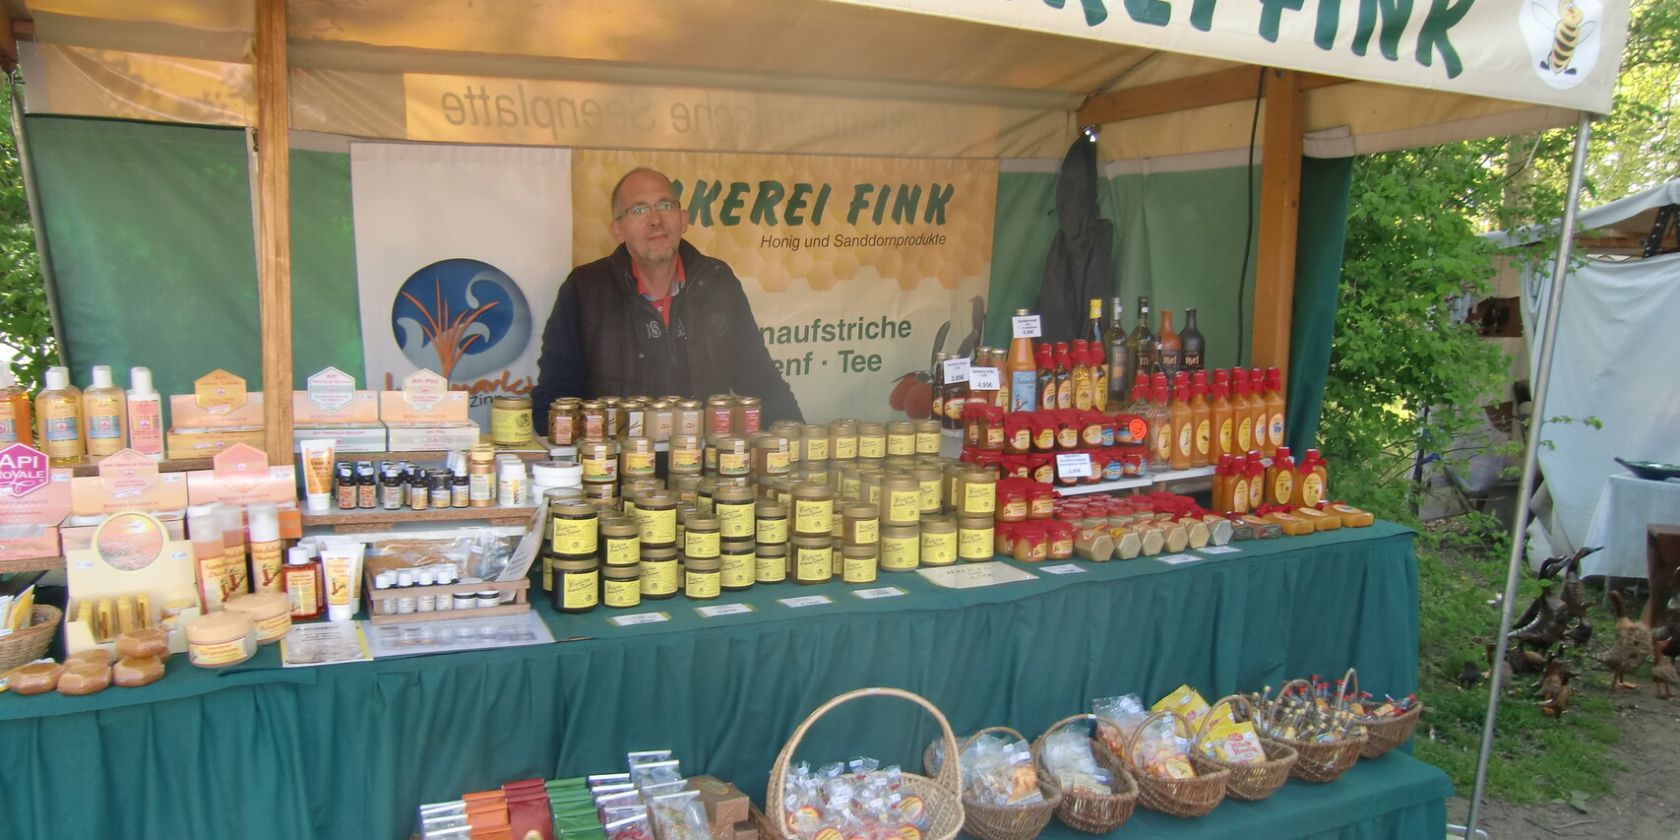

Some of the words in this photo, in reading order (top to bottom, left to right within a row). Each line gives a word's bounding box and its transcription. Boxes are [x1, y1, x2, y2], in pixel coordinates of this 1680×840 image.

[671, 179, 832, 228] KEREI
[846, 182, 955, 226] FINK
[761, 234, 801, 251] Honig
[804, 234, 831, 249] und
[833, 232, 946, 251] Sanddornprodukte
[759, 316, 912, 345] naufstriche
[773, 351, 813, 377] enf
[838, 350, 882, 374] Tee
[0, 453, 39, 469] API
[0, 470, 45, 481] OYALE
